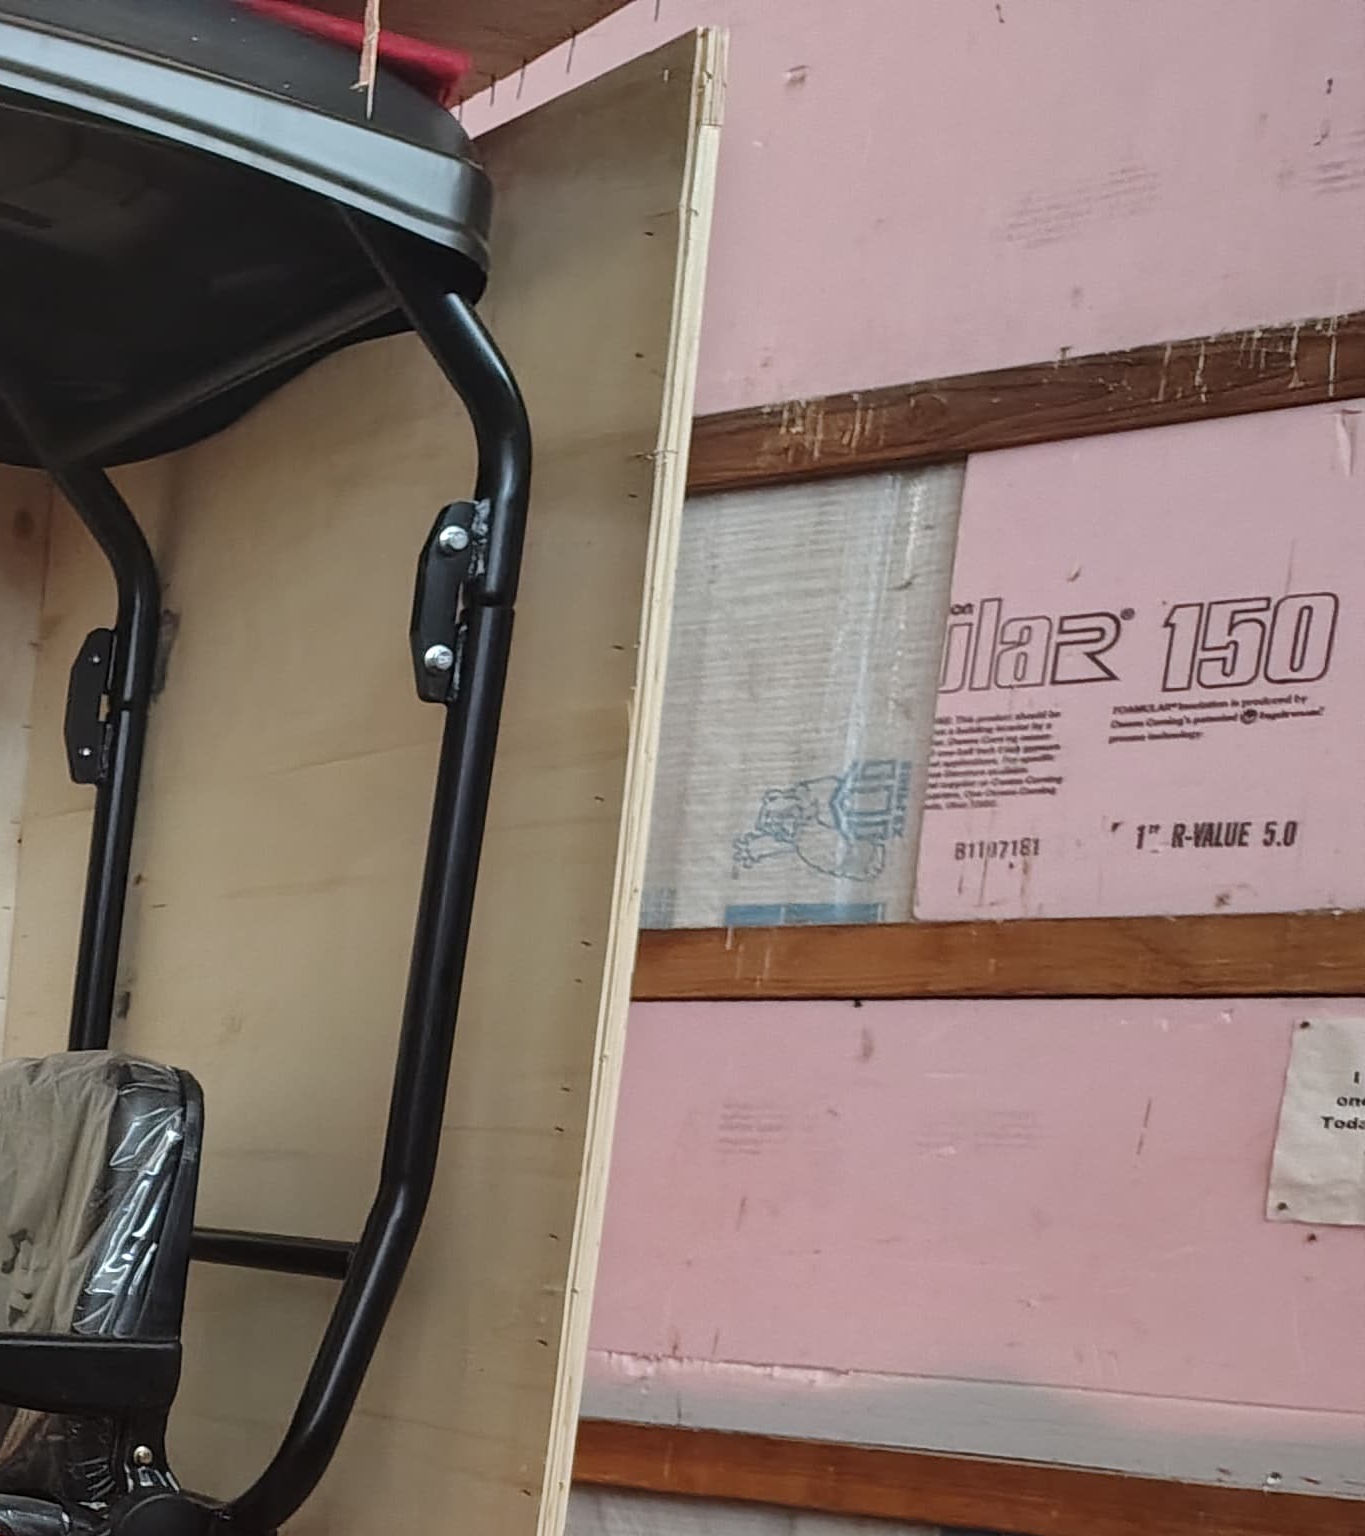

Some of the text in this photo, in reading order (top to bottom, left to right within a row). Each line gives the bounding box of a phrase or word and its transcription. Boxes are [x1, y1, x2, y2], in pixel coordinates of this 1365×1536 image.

[1161, 592, 1340, 692] 150
[1171, 821, 1252, 848] R-VALUE
[1262, 820, 1298, 847] 5.0
